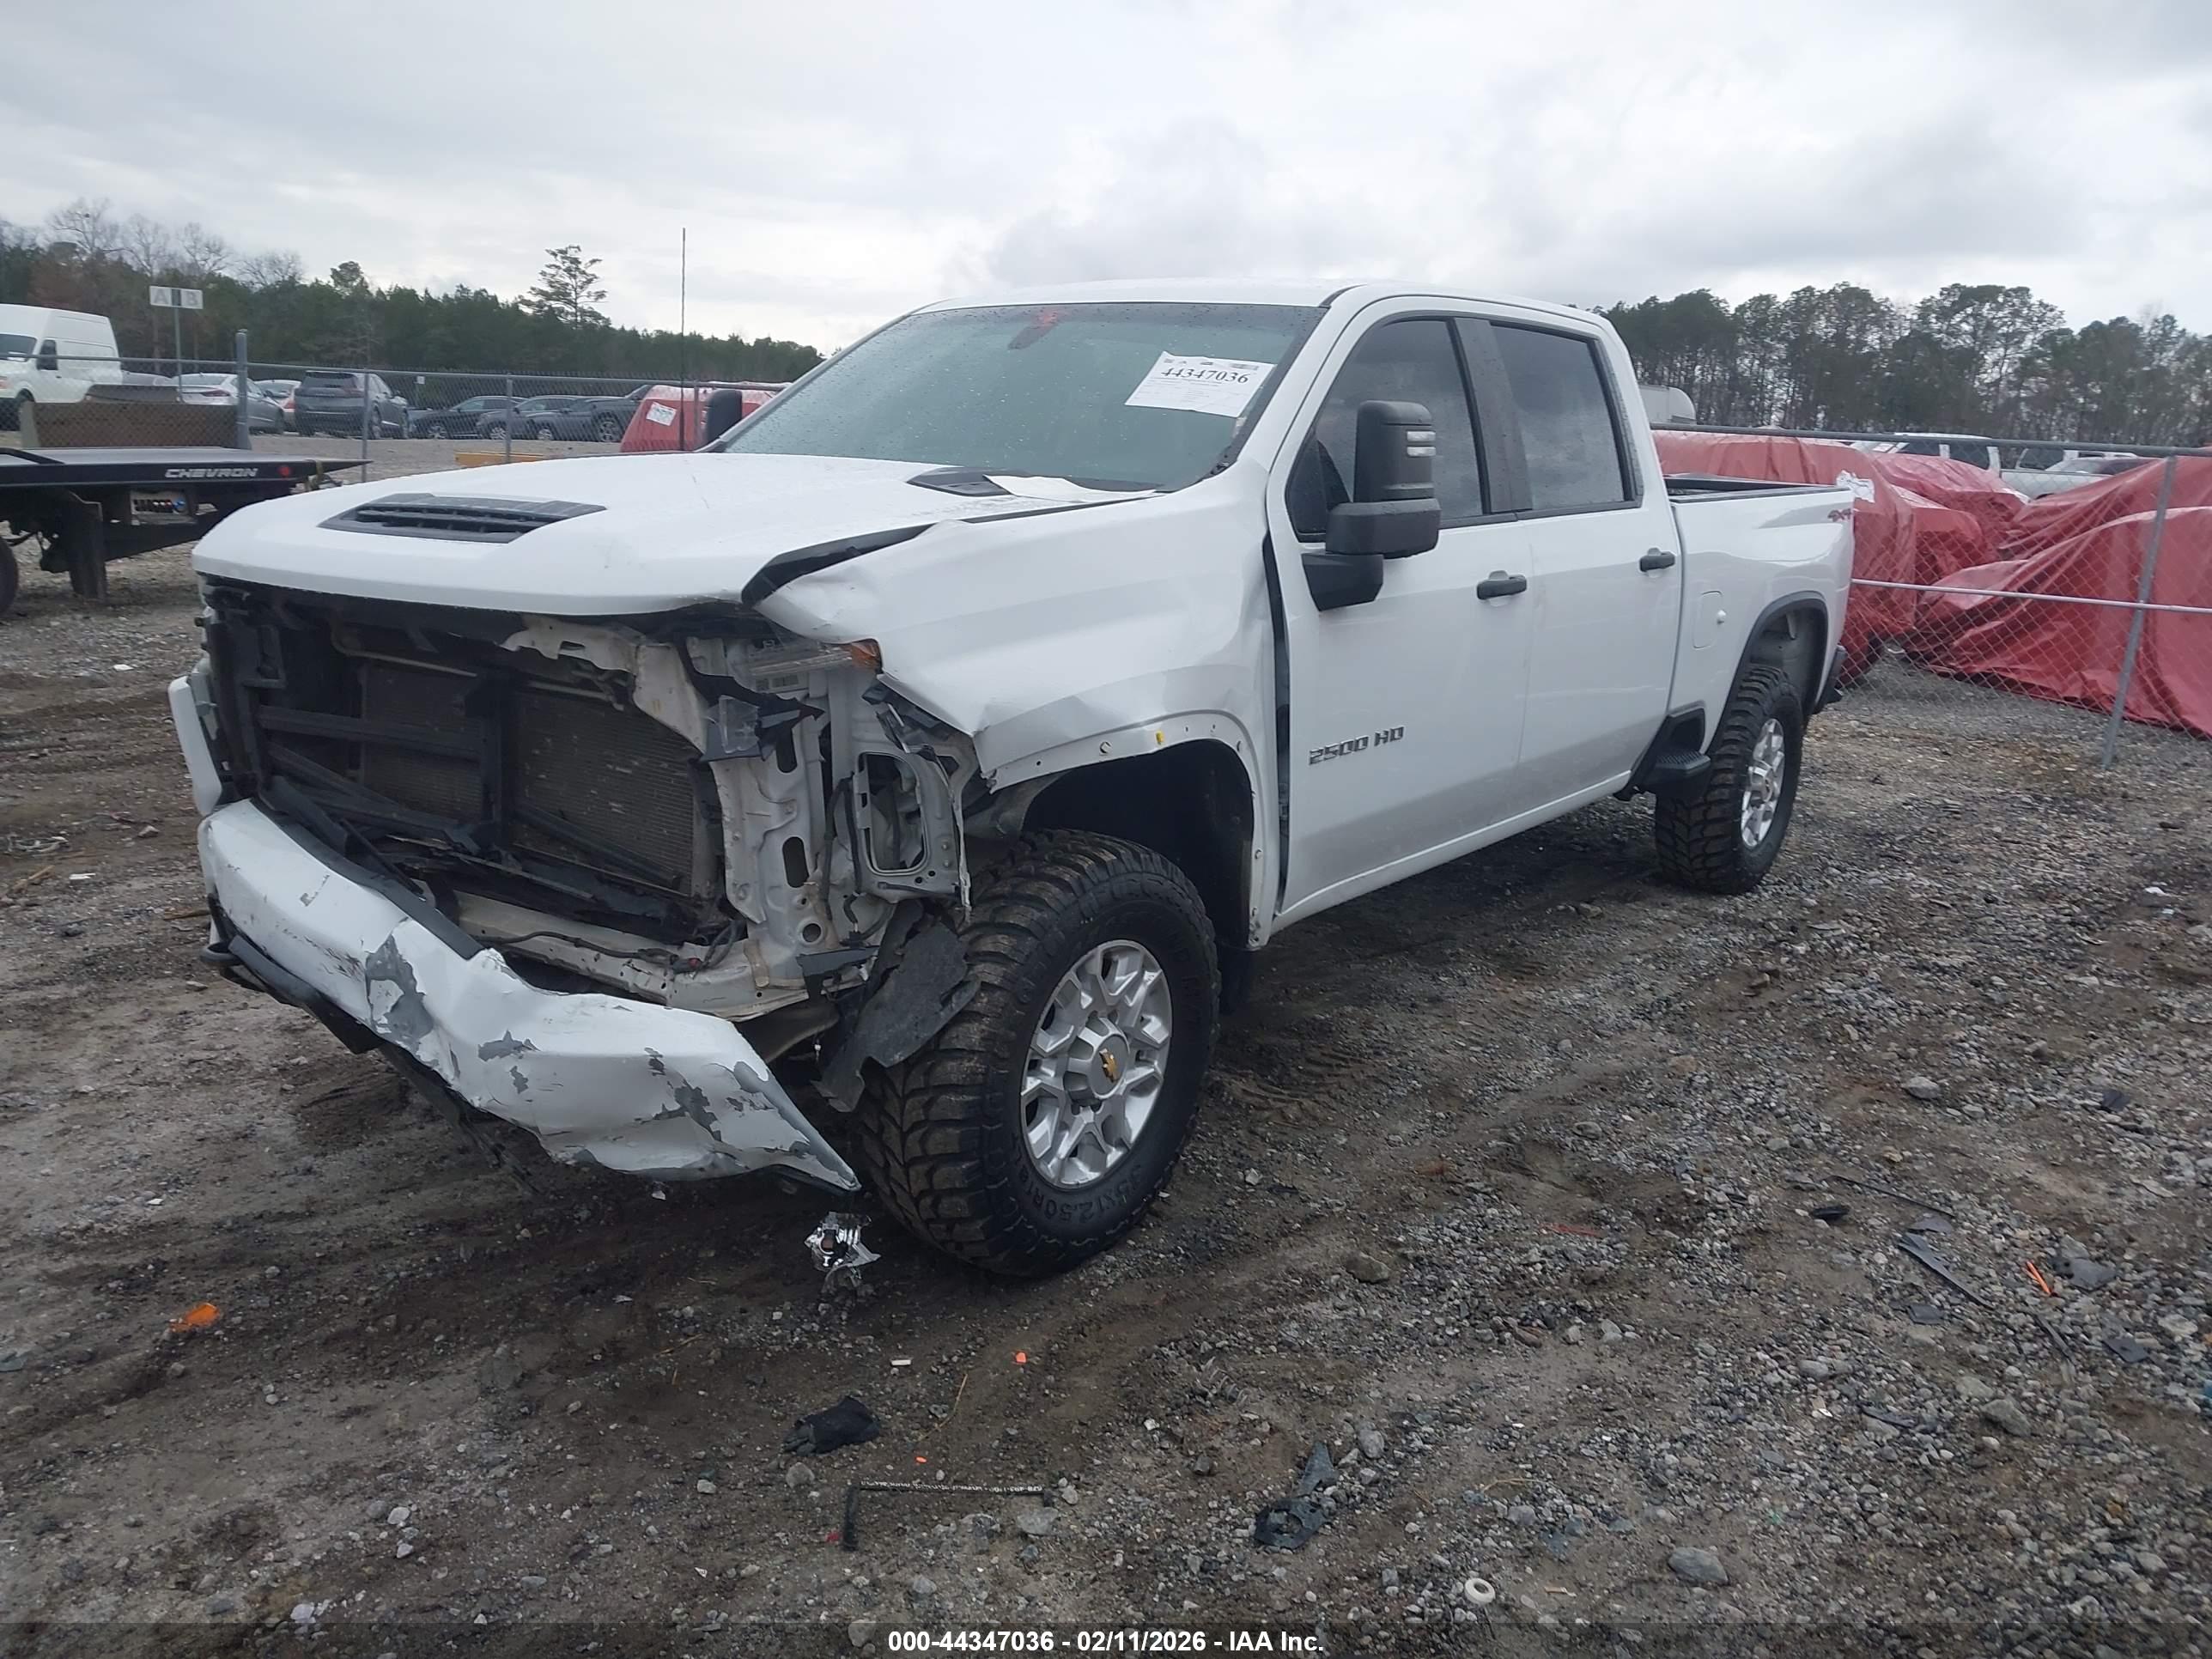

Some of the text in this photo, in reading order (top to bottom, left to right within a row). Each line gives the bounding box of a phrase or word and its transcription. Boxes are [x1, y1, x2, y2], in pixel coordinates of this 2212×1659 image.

[153, 289, 169, 304] A
[1161, 368, 1251, 384] 44347036
[165, 467, 258, 478] CHEVRON
[1309, 726, 1405, 765] 2500 HD
